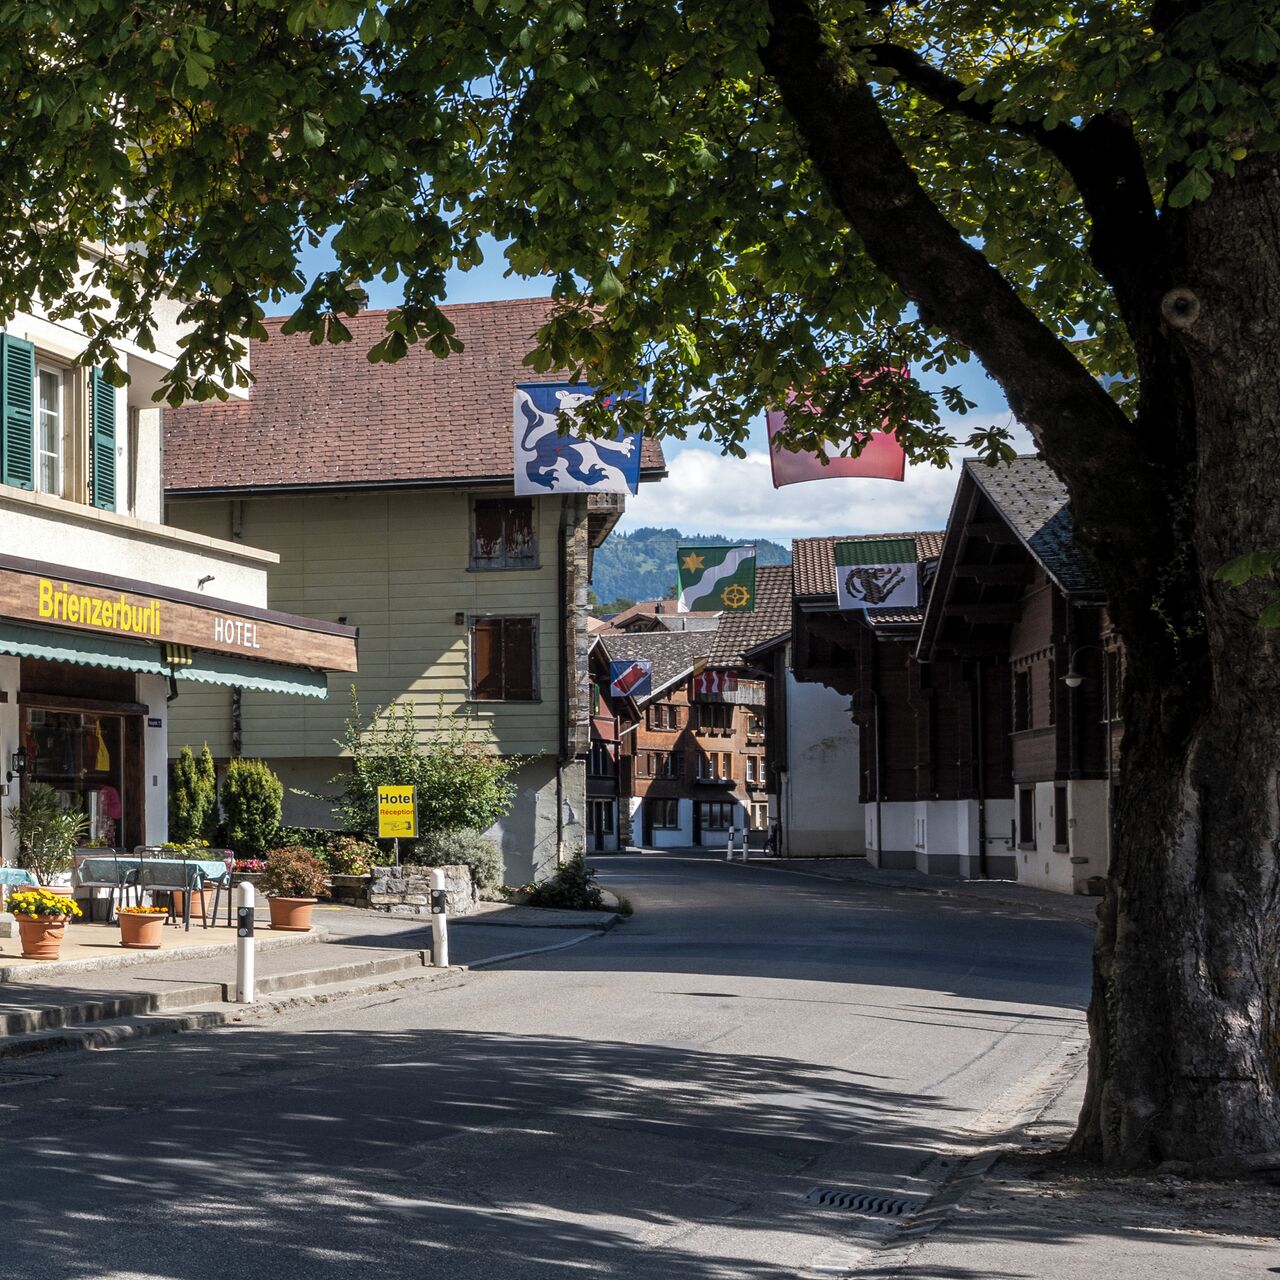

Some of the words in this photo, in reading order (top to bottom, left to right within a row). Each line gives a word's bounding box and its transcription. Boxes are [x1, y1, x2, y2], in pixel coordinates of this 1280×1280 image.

[38, 578, 161, 636] Brienzerburli
[214, 616, 261, 649] HOTEL
[380, 793, 415, 804] Hotel
